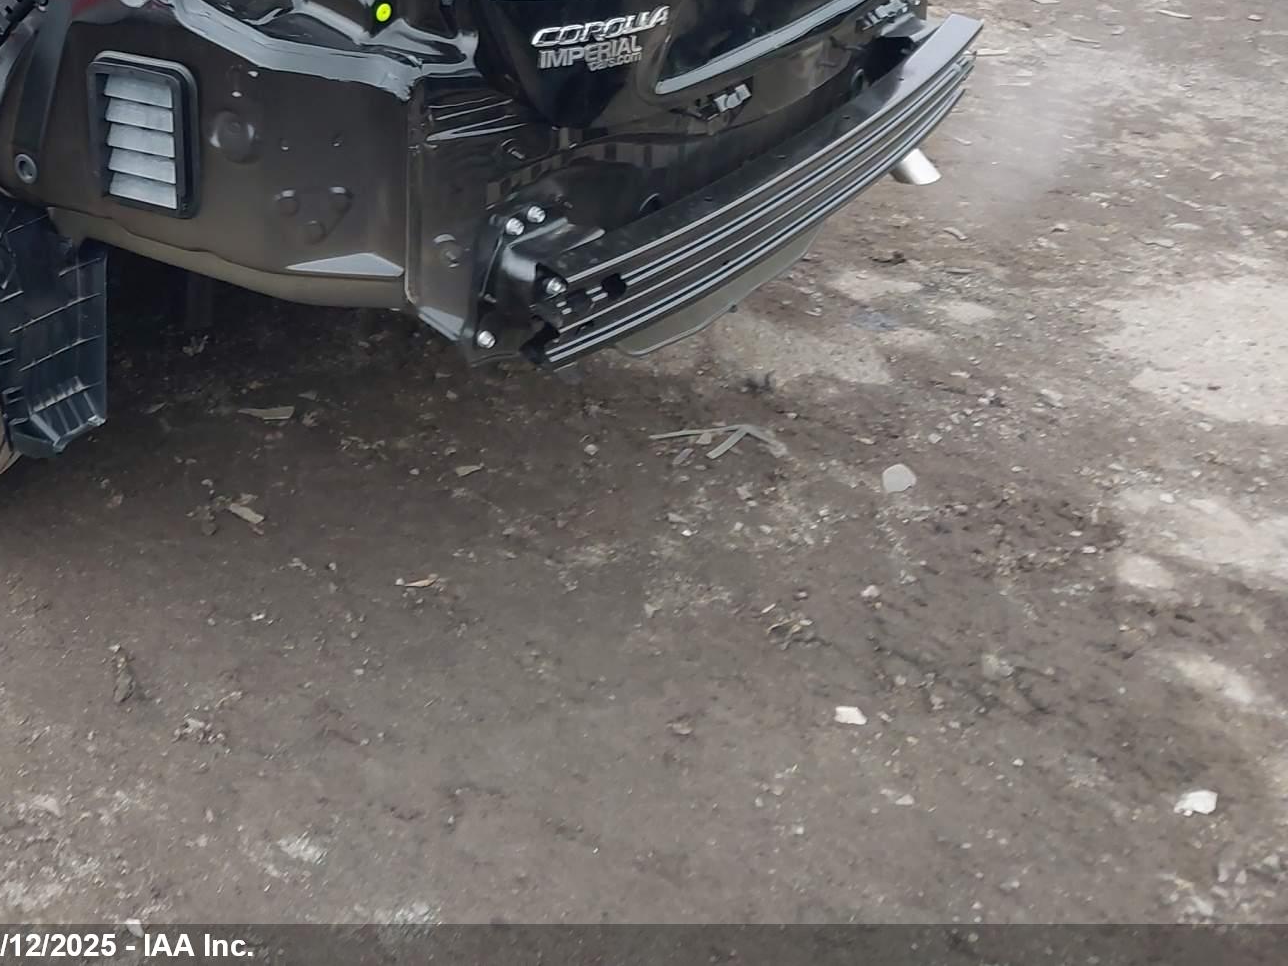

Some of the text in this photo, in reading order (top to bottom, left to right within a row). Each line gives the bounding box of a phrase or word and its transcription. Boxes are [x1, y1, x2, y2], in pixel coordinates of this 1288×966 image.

[531, 5, 670, 47] COROLLA
[538, 34, 643, 70] IMPERIAL
[585, 51, 642, 72] cars.com
